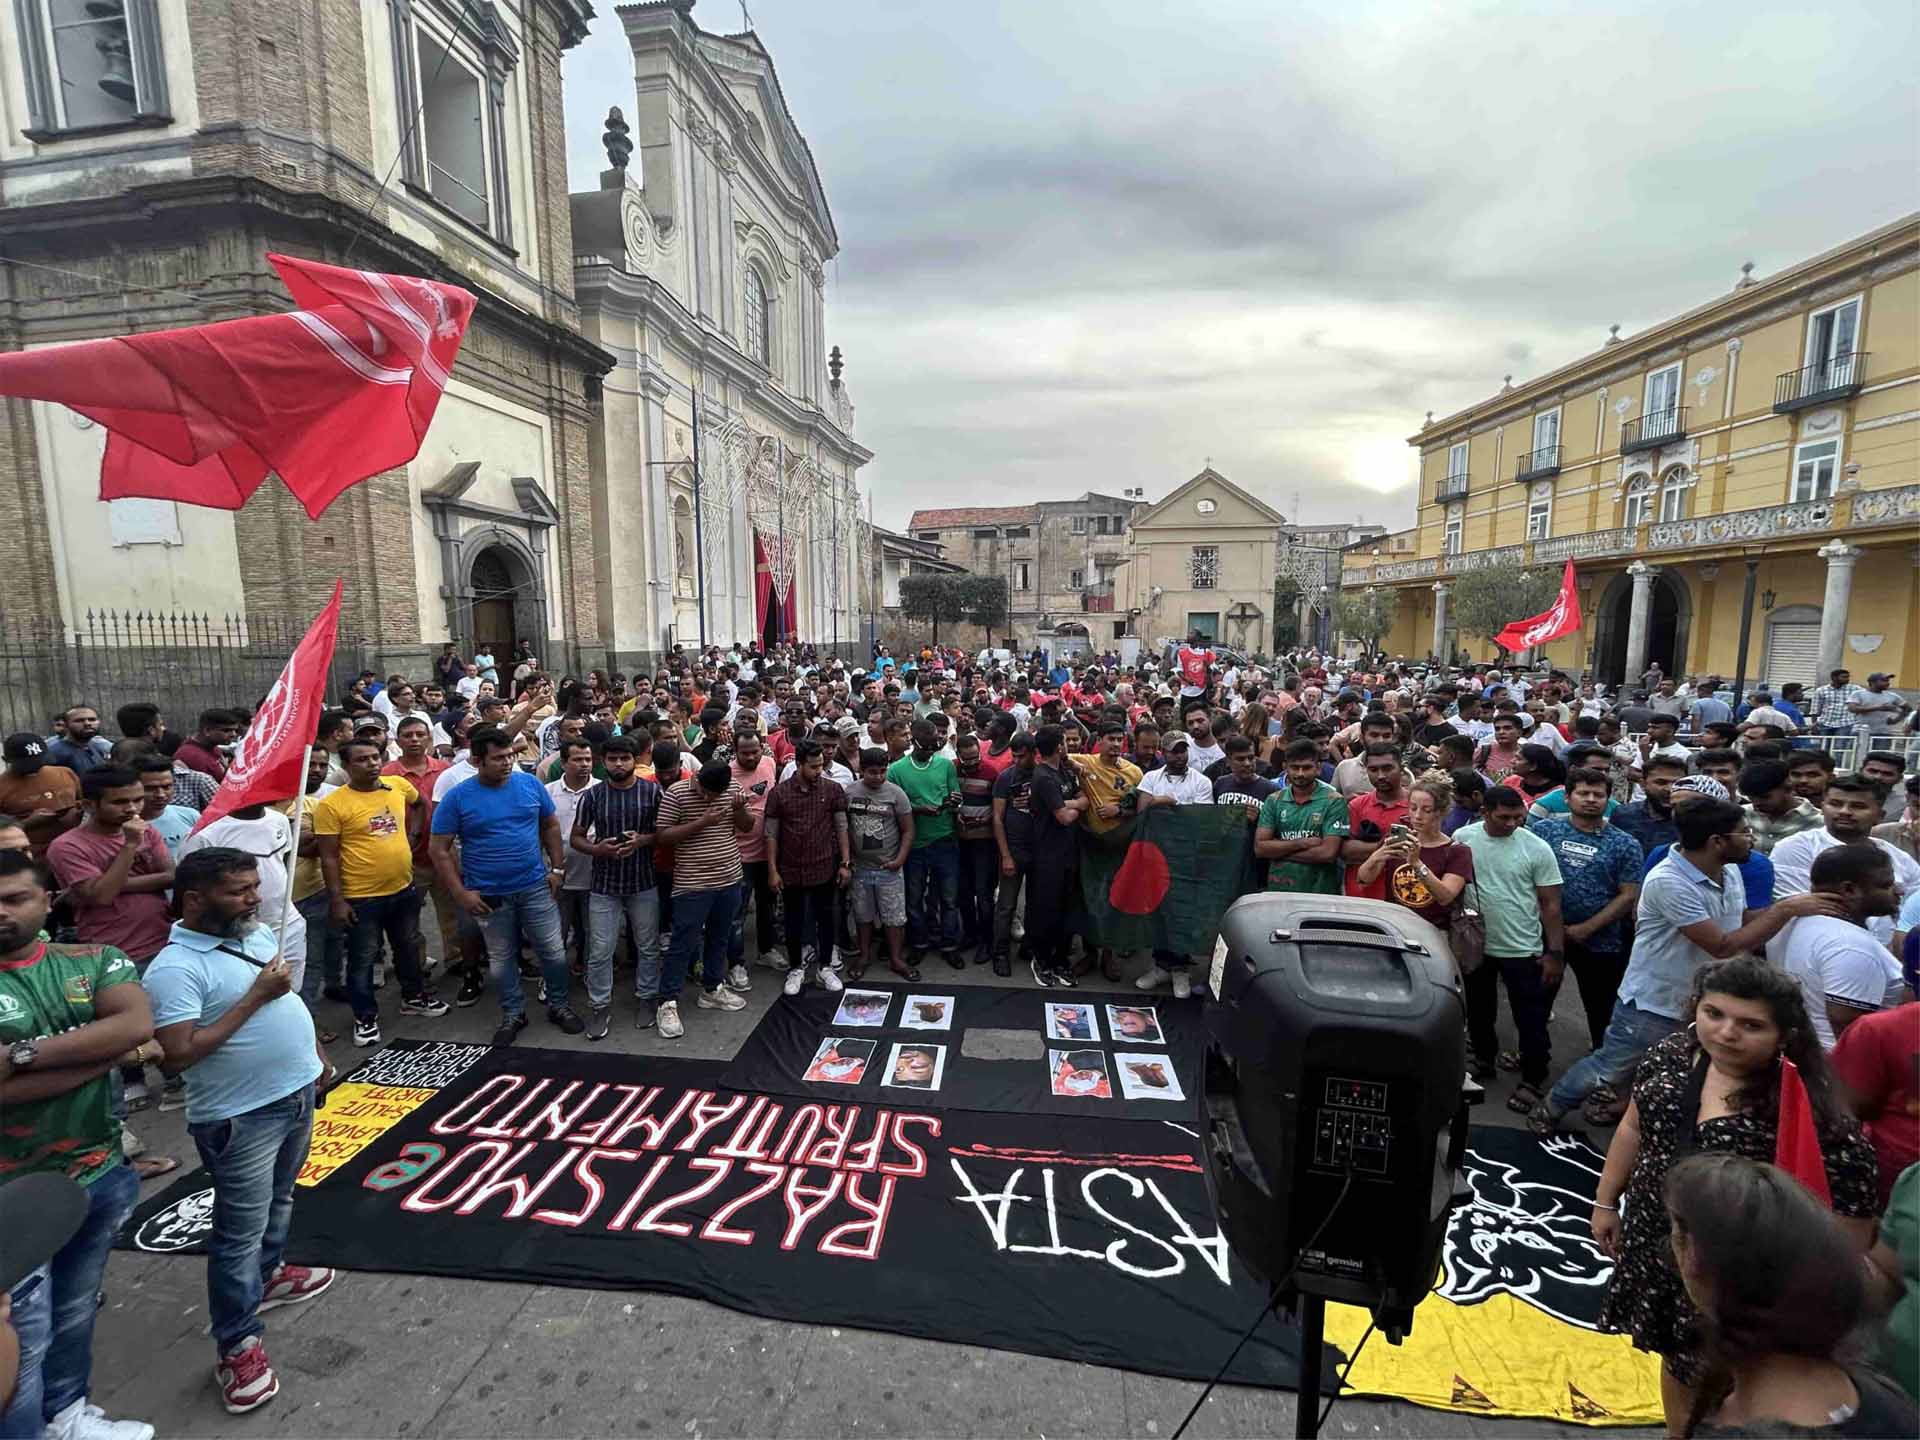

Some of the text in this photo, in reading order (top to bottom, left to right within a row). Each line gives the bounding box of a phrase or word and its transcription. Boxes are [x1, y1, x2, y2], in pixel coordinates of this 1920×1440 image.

[415, 1042, 492, 1056] NAPOLI
[347, 1067, 455, 1087] MOVIMENTO
[332, 1101, 413, 1119] SALUTE
[430, 1074, 942, 1176] SFRUTTAMENTO
[362, 1138, 897, 1261] RAZZISMO e
[950, 1158, 1231, 1286] ASTA
[1326, 1256, 1363, 1269] gemini
